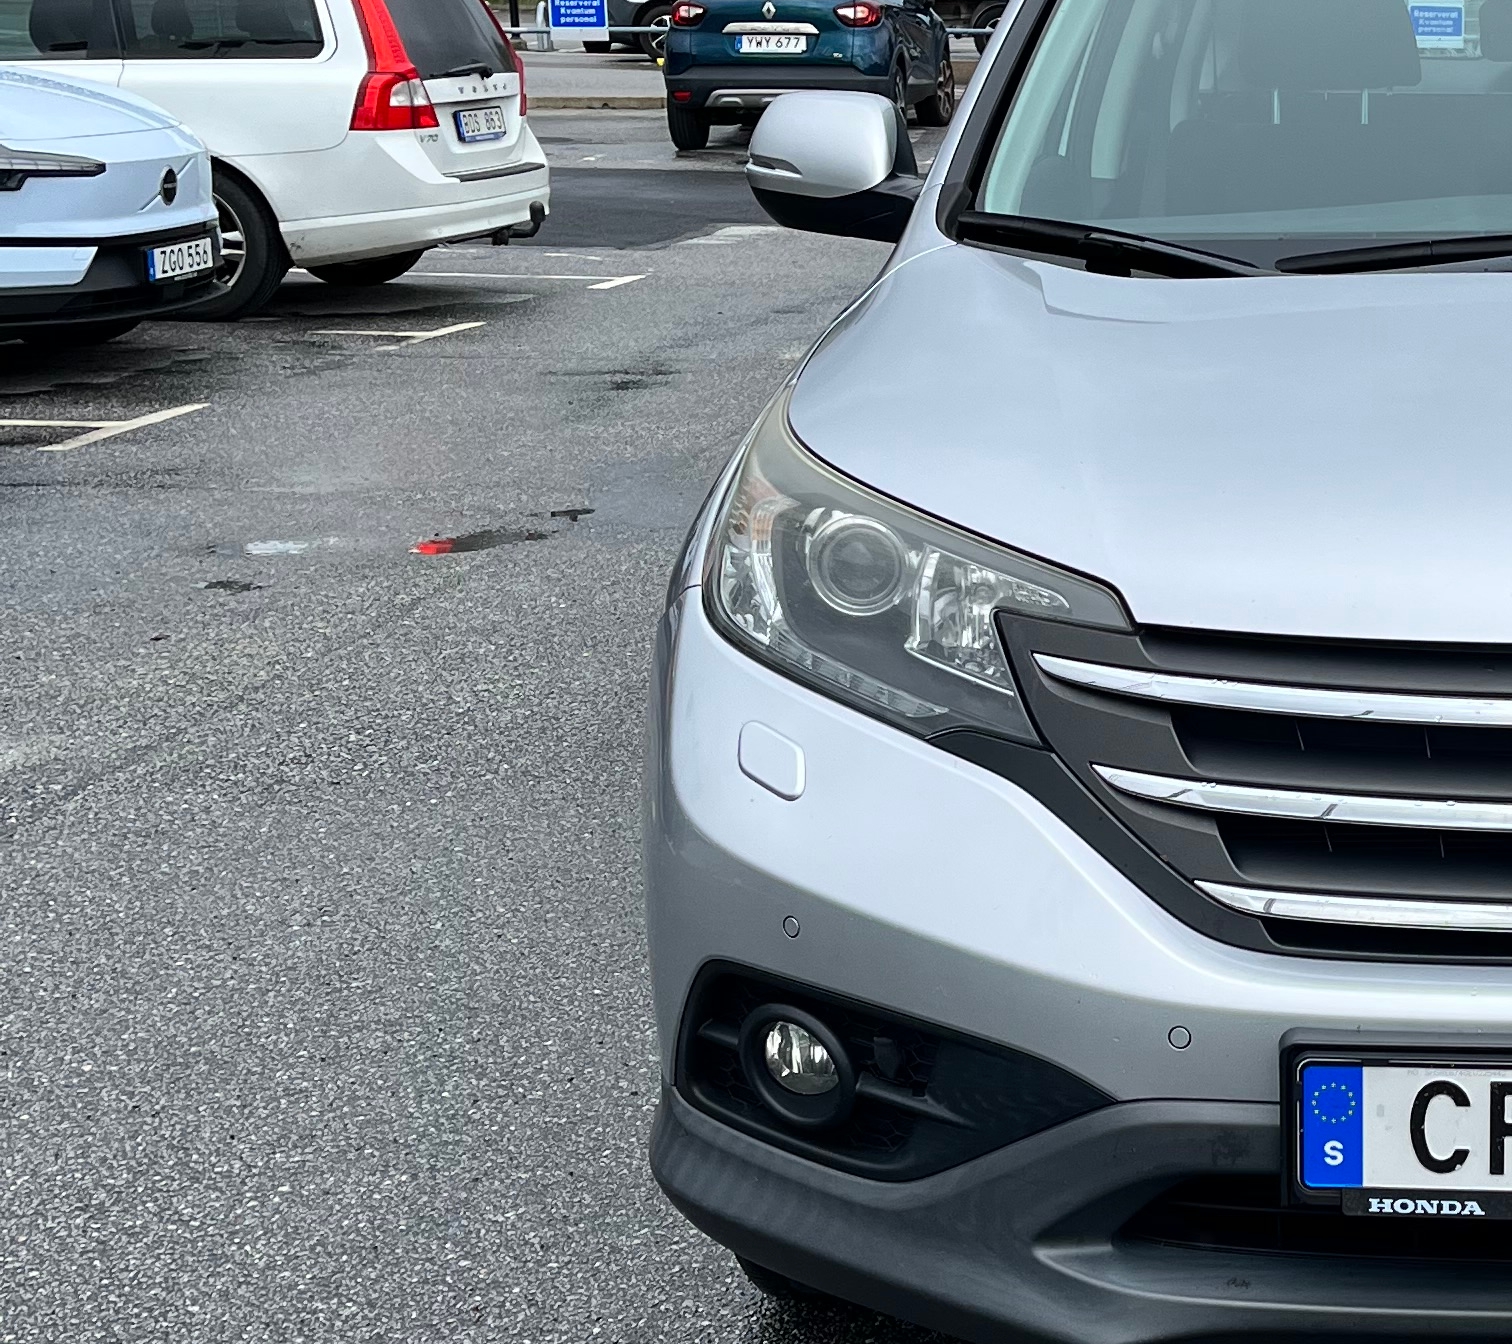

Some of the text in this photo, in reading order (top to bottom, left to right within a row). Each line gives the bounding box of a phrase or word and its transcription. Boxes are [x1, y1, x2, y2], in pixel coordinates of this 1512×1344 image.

[747, 36, 800, 48] YWY 677
[160, 242, 208, 275] ZGO 556
[1323, 1140, 1344, 1165] S
[1368, 1198, 1485, 1216] HONDA
